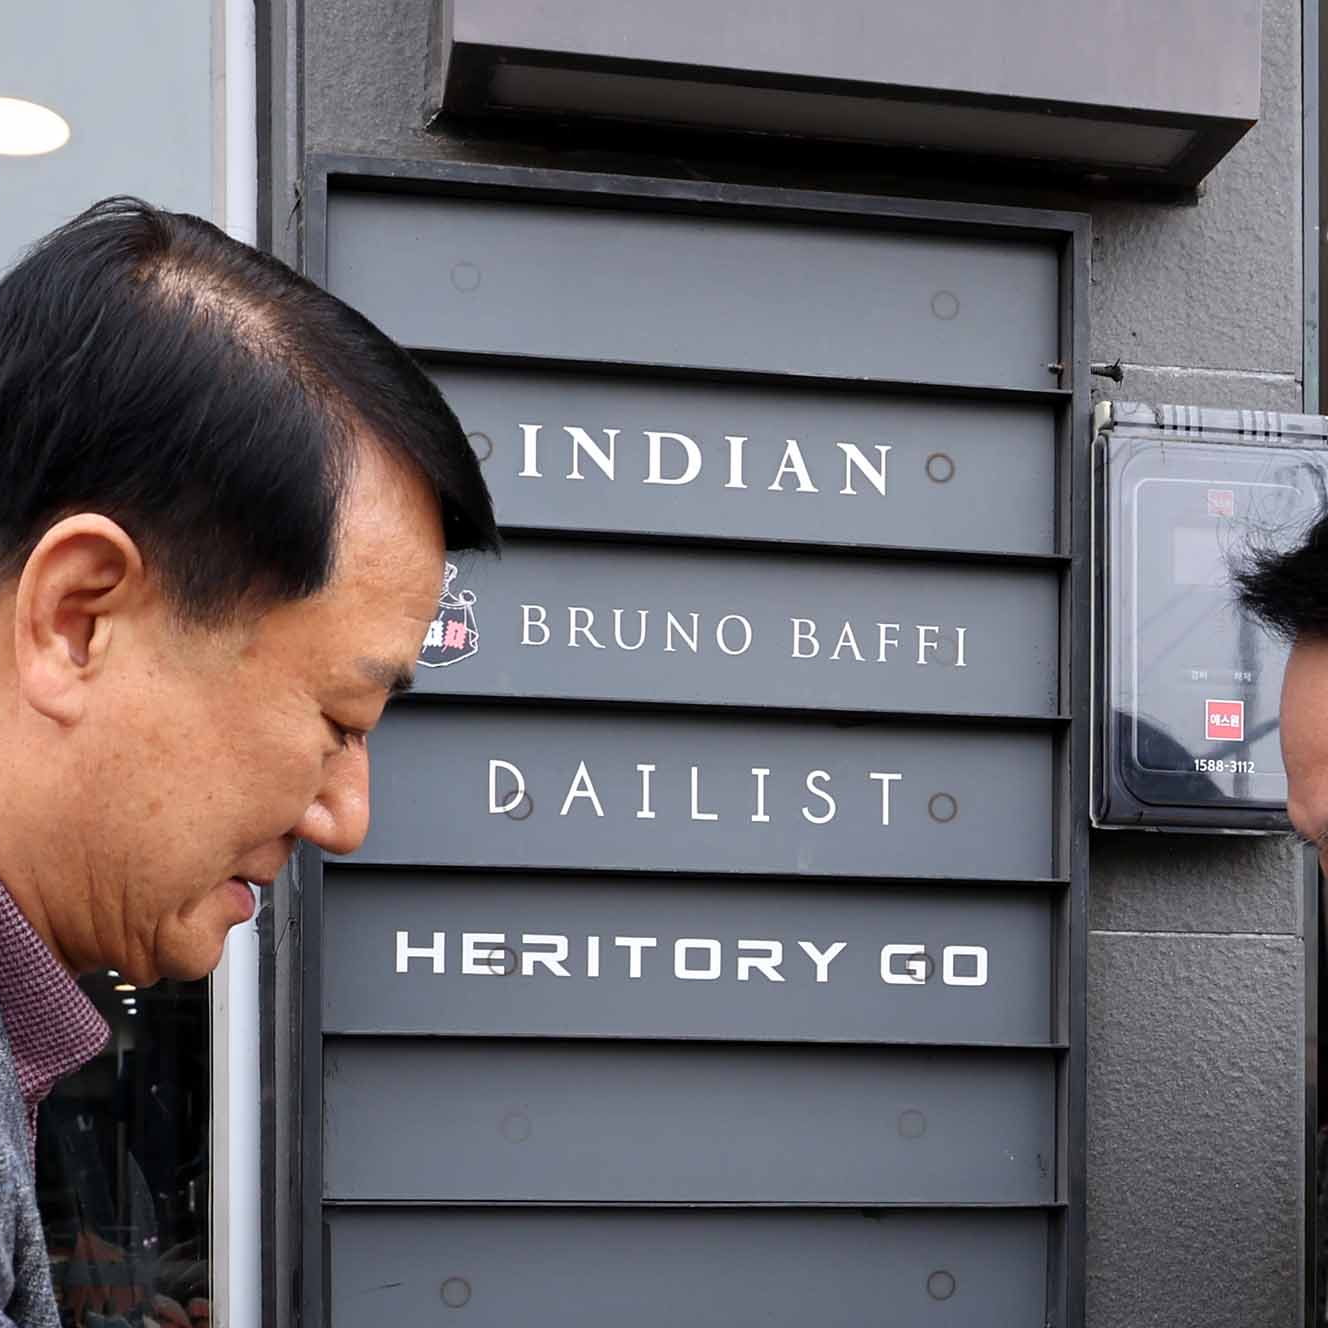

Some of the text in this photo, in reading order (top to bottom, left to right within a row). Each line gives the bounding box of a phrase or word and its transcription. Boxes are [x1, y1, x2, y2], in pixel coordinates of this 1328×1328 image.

[518, 423, 892, 496] INDIAN
[520, 604, 968, 667] BRUNO BAFFI
[1210, 714, 1240, 728] 에스원
[489, 759, 902, 826] DAILIST
[1194, 759, 1256, 774] 1588-3112
[396, 931, 989, 987] HERITORY GO
